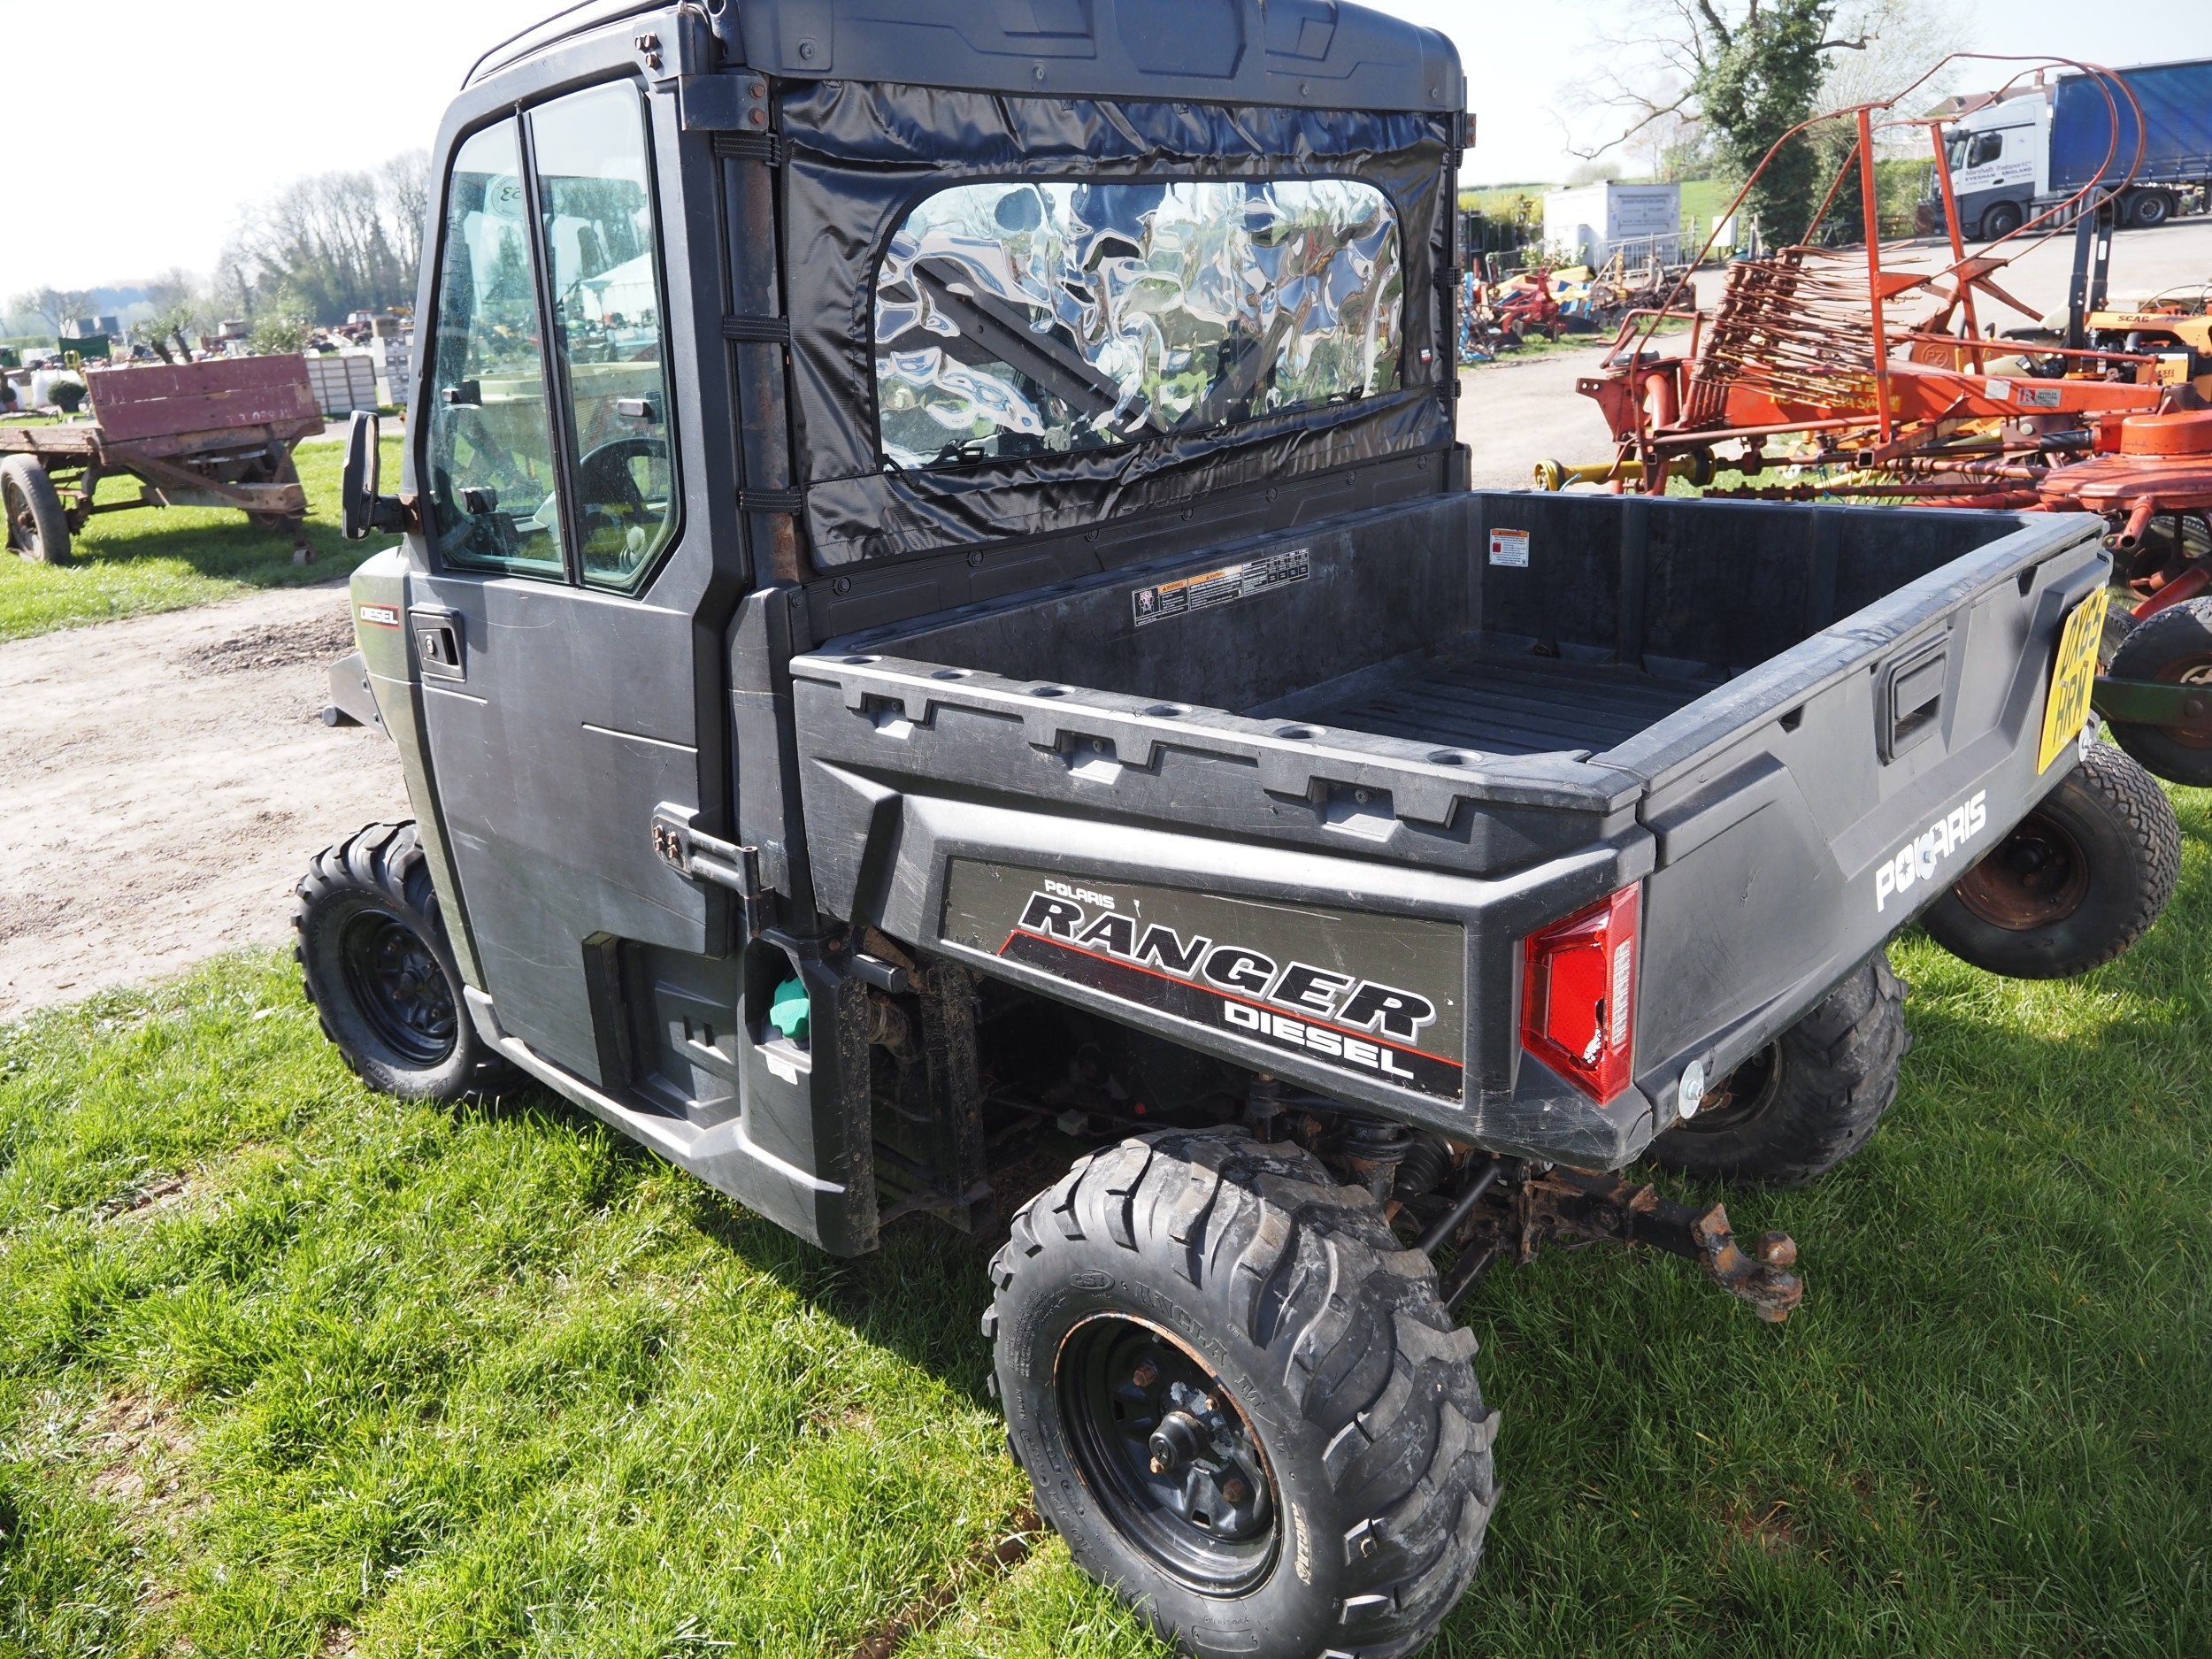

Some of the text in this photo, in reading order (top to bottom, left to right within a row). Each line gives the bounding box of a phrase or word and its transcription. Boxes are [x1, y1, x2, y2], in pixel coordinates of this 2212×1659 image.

[2001, 166, 2032, 176] ENGLAND
[2117, 315, 2150, 324] SCAG
[1925, 349, 1945, 363] PZ
[360, 606, 399, 625] DIESEL
[2052, 666, 2089, 749] HRM
[1044, 879, 1115, 910] POLARIS
[1018, 891, 1438, 1044] RANGER
[1224, 1000, 1415, 1080] DIESEL
